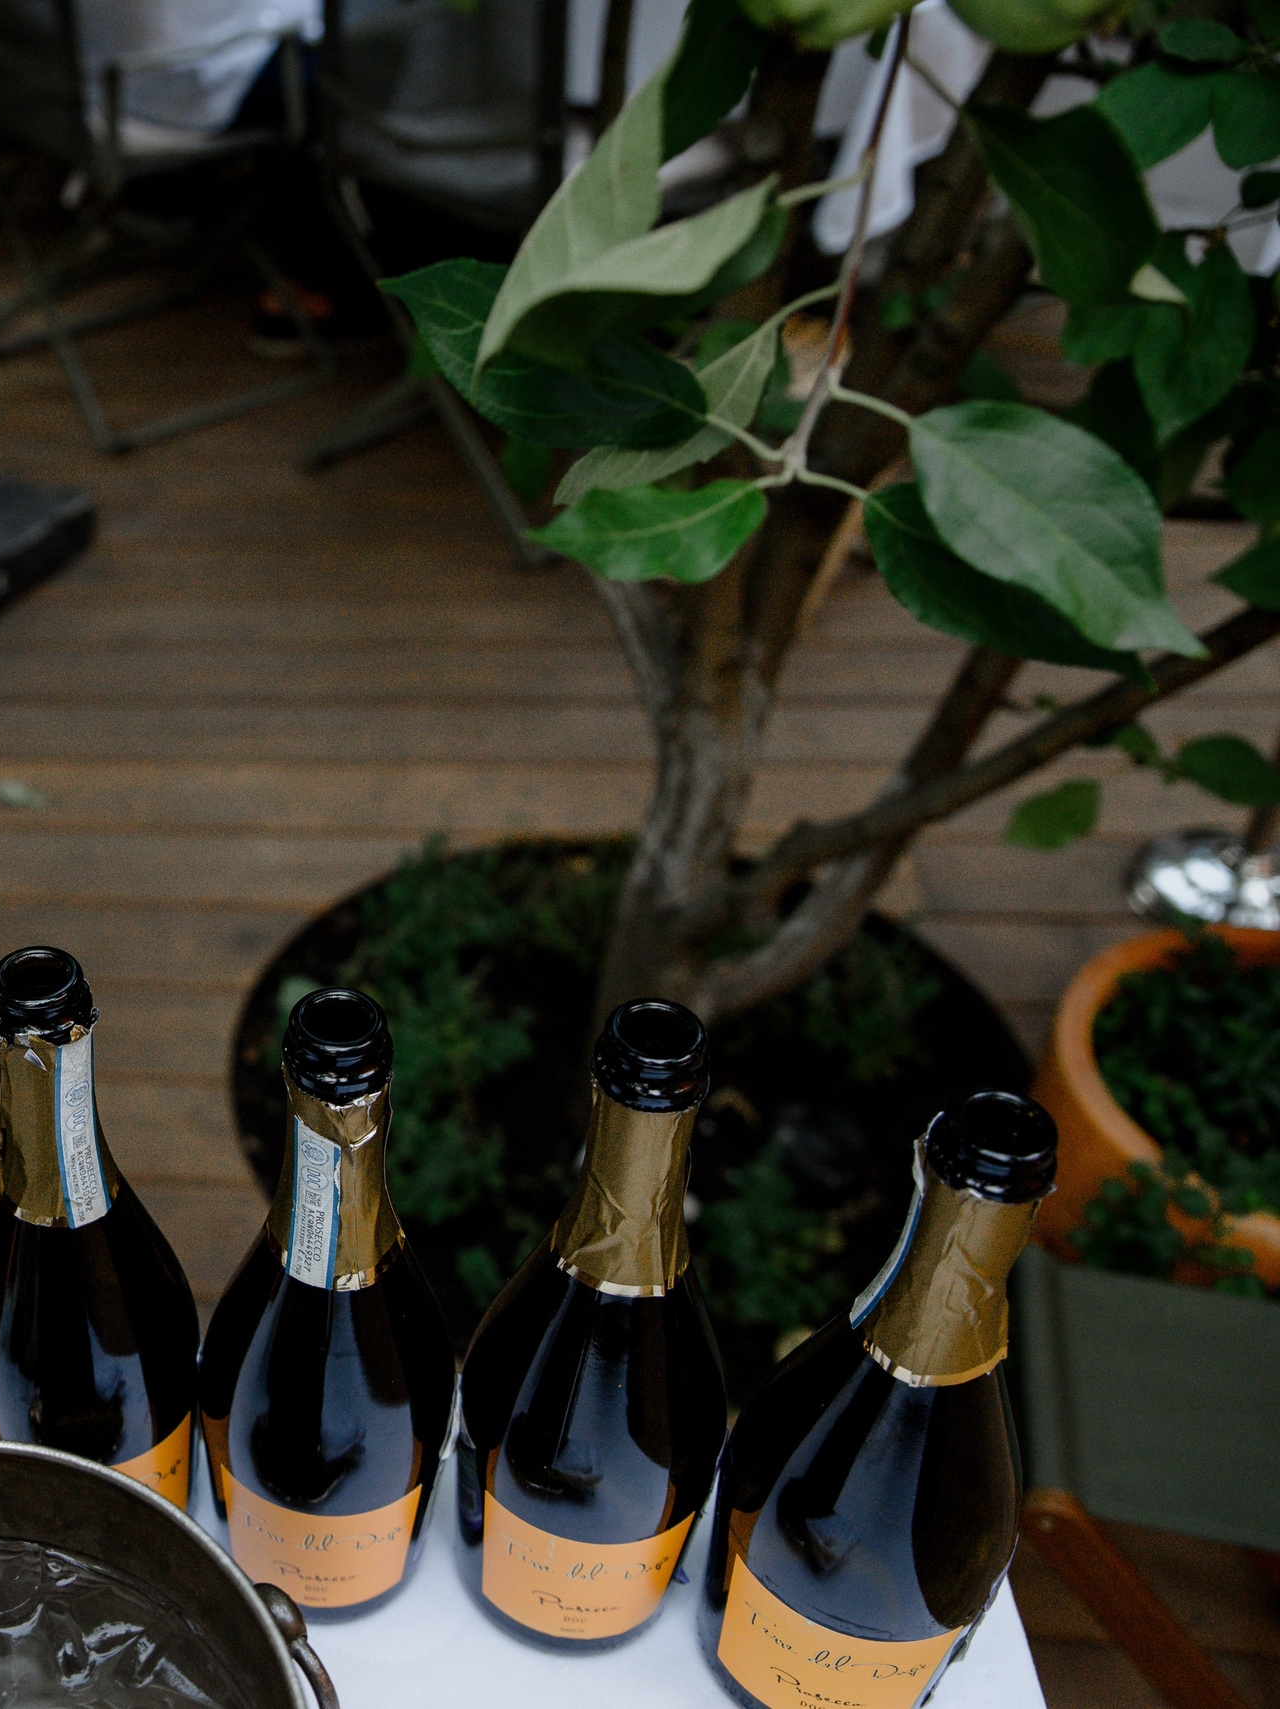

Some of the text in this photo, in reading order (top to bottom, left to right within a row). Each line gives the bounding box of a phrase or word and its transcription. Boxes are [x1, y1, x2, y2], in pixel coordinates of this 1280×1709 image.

[72, 1108, 86, 1129] DOC
[86, 1145, 98, 1195] PROSECCO
[305, 1167, 321, 1188] DOC
[76, 1201, 85, 1222] 0.750
[313, 1209, 325, 1262] PROSECCO
[564, 1562, 604, 1582] del
[532, 1590, 622, 1613] Prosecco
[807, 1650, 852, 1674] del
[770, 1666, 867, 1707] Prosecco
